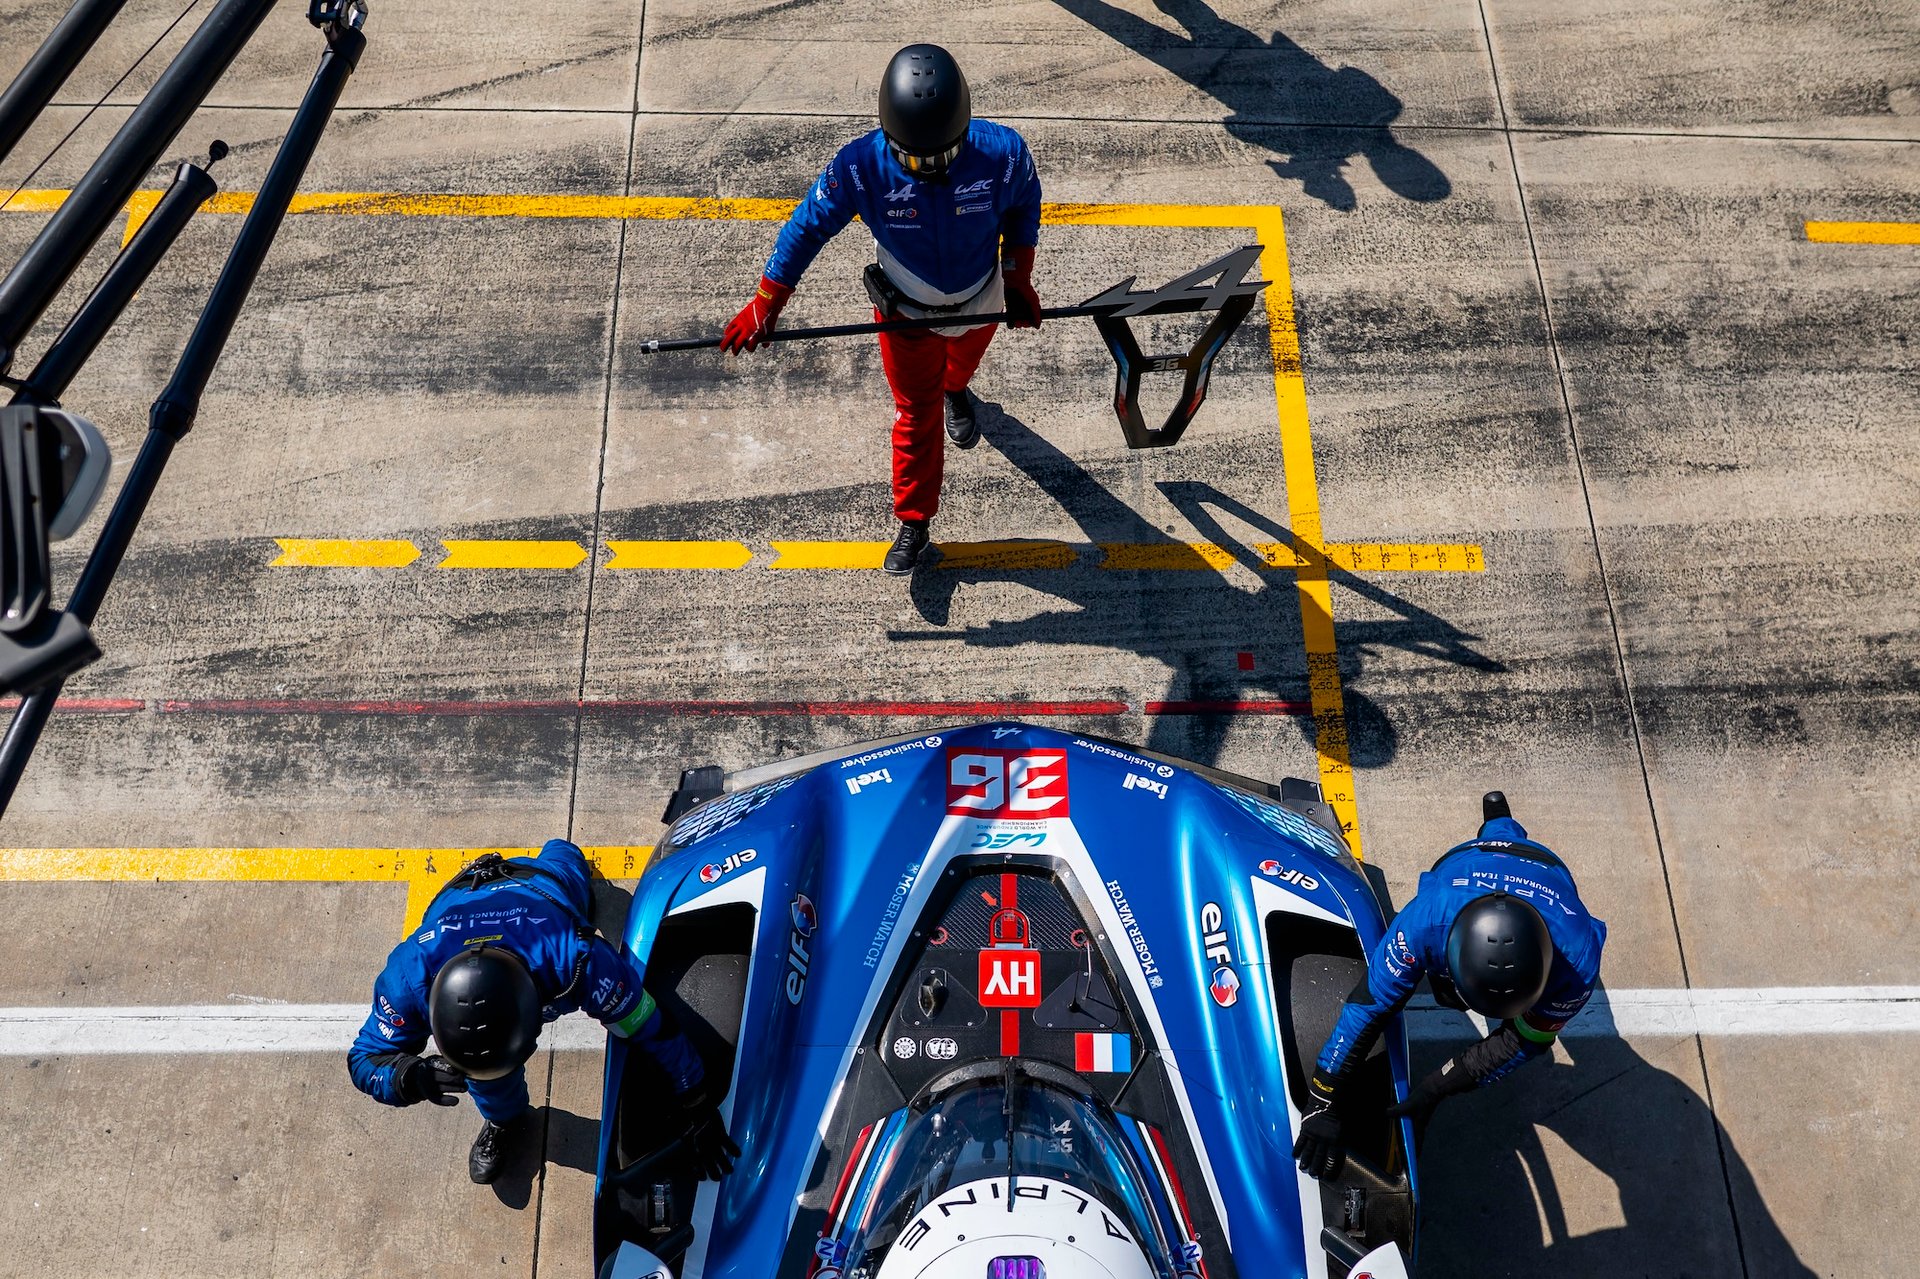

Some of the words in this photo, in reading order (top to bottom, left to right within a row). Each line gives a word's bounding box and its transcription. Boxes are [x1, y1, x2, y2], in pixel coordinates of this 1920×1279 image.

[954, 179, 993, 194] WEC
[887, 209, 905, 217] elf
[1152, 358, 1179, 371] 36
[841, 740, 925, 769] businessolver
[1073, 739, 1157, 773] businessolver
[845, 767, 893, 795] ixell
[948, 753, 1066, 811] 36
[1329, 764, 1343, 773] 20
[1122, 772, 1169, 800] ixell
[1333, 793, 1346, 802] 10
[971, 832, 1047, 849] WEC
[721, 848, 758, 875] elf
[1281, 866, 1320, 891] elf
[1473, 871, 1499, 880] TEAM
[1503, 874, 1560, 900] ENDURANCE
[1452, 878, 1577, 916] ALPINE
[437, 914, 463, 925] TEAM
[469, 907, 528, 919] ENDURANCE
[863, 873, 918, 969] MOSER.WATCH
[418, 916, 548, 944] ALPINE
[1106, 879, 1159, 978] MOSER.WATCH
[1200, 902, 1232, 968] elf
[786, 931, 810, 1006] elf
[984, 960, 1035, 996] HY
[380, 995, 396, 1015] elf
[378, 1021, 395, 1040] ixell
[899, 1182, 1133, 1251] ALPINE
